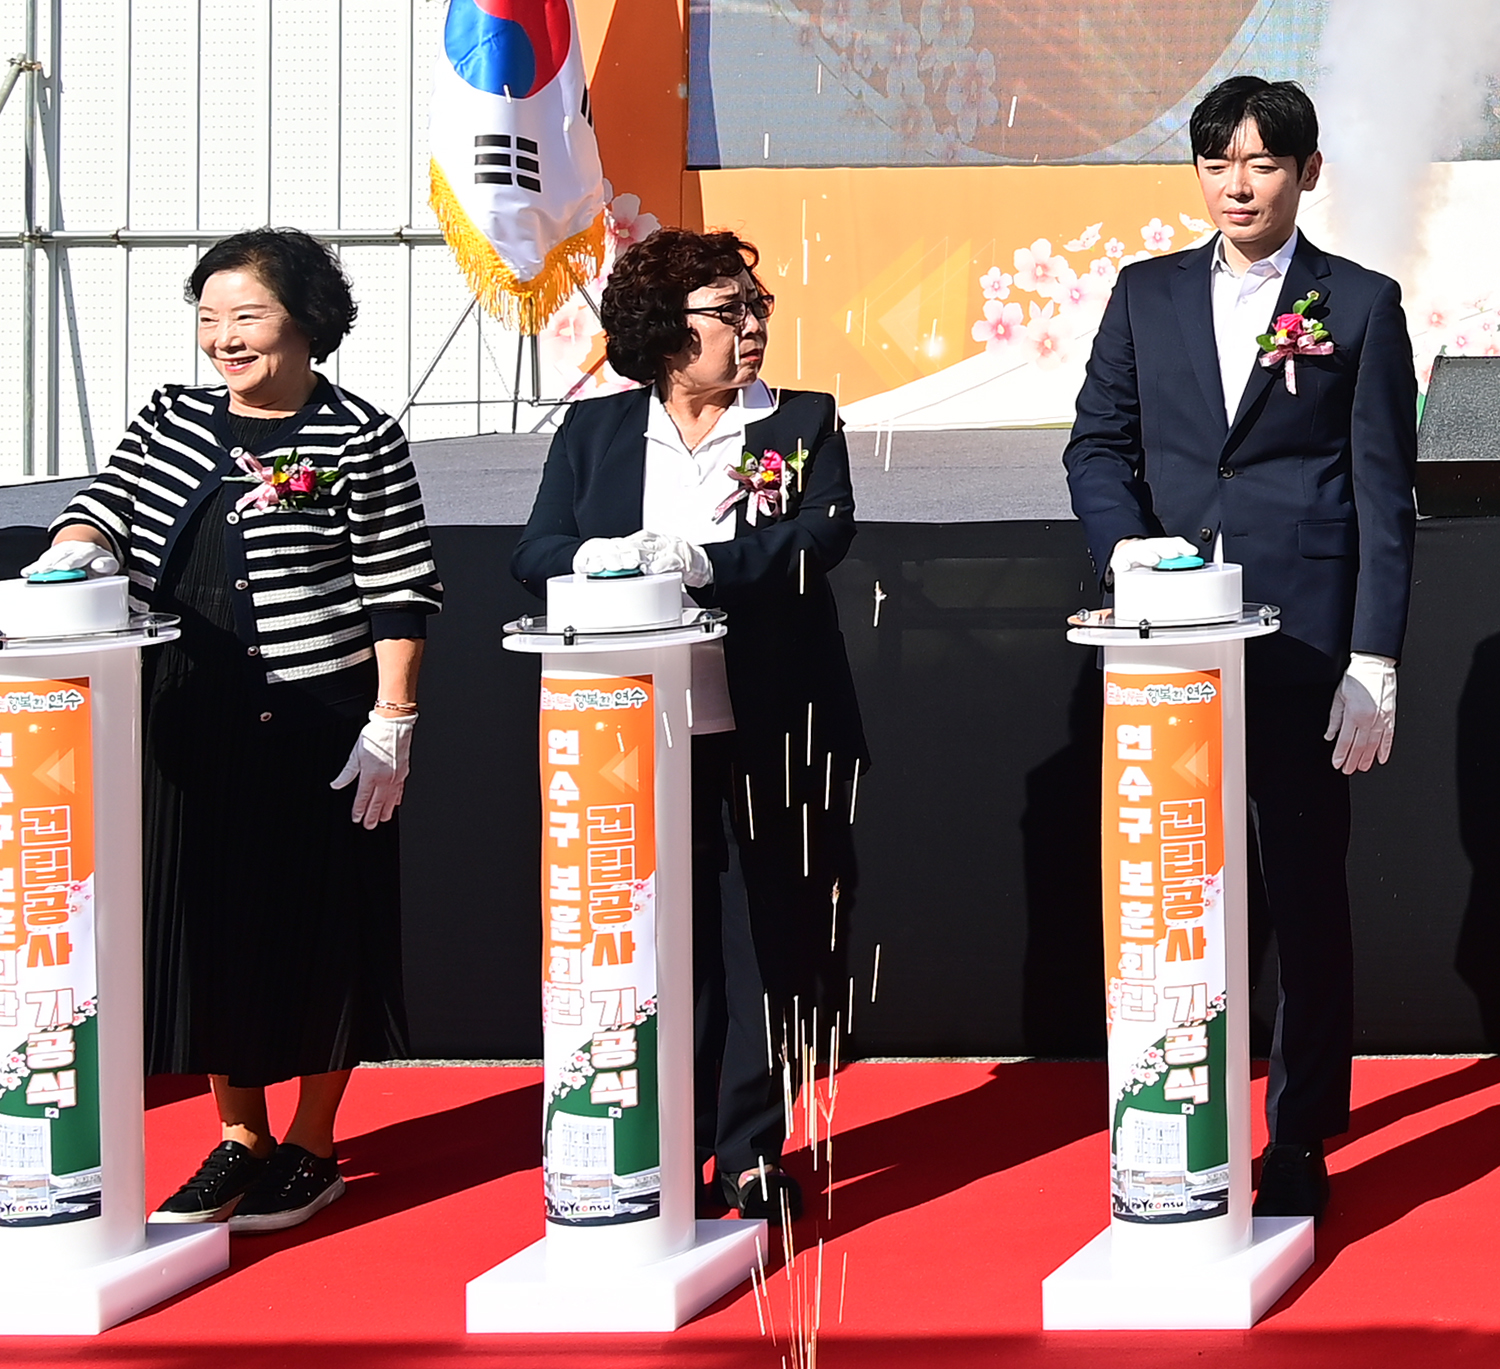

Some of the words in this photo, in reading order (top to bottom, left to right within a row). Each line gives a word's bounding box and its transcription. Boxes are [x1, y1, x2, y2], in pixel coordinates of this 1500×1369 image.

[49, 692, 81, 709] 연수
[615, 690, 646, 707] 연수
[1187, 684, 1215, 702] 연수
[548, 729, 580, 848] 연수구
[1117, 724, 1153, 844] 연수구
[20, 805, 71, 968] 건립공사
[587, 804, 635, 967] 건립공사
[1120, 860, 1156, 1023] 보훈회관
[1160, 799, 1206, 963] 건립공사
[548, 865, 582, 1027] 보훈회관
[25, 988, 77, 1110] 기공식
[590, 986, 639, 1108] 기공식
[1163, 982, 1209, 1106] 기공식
